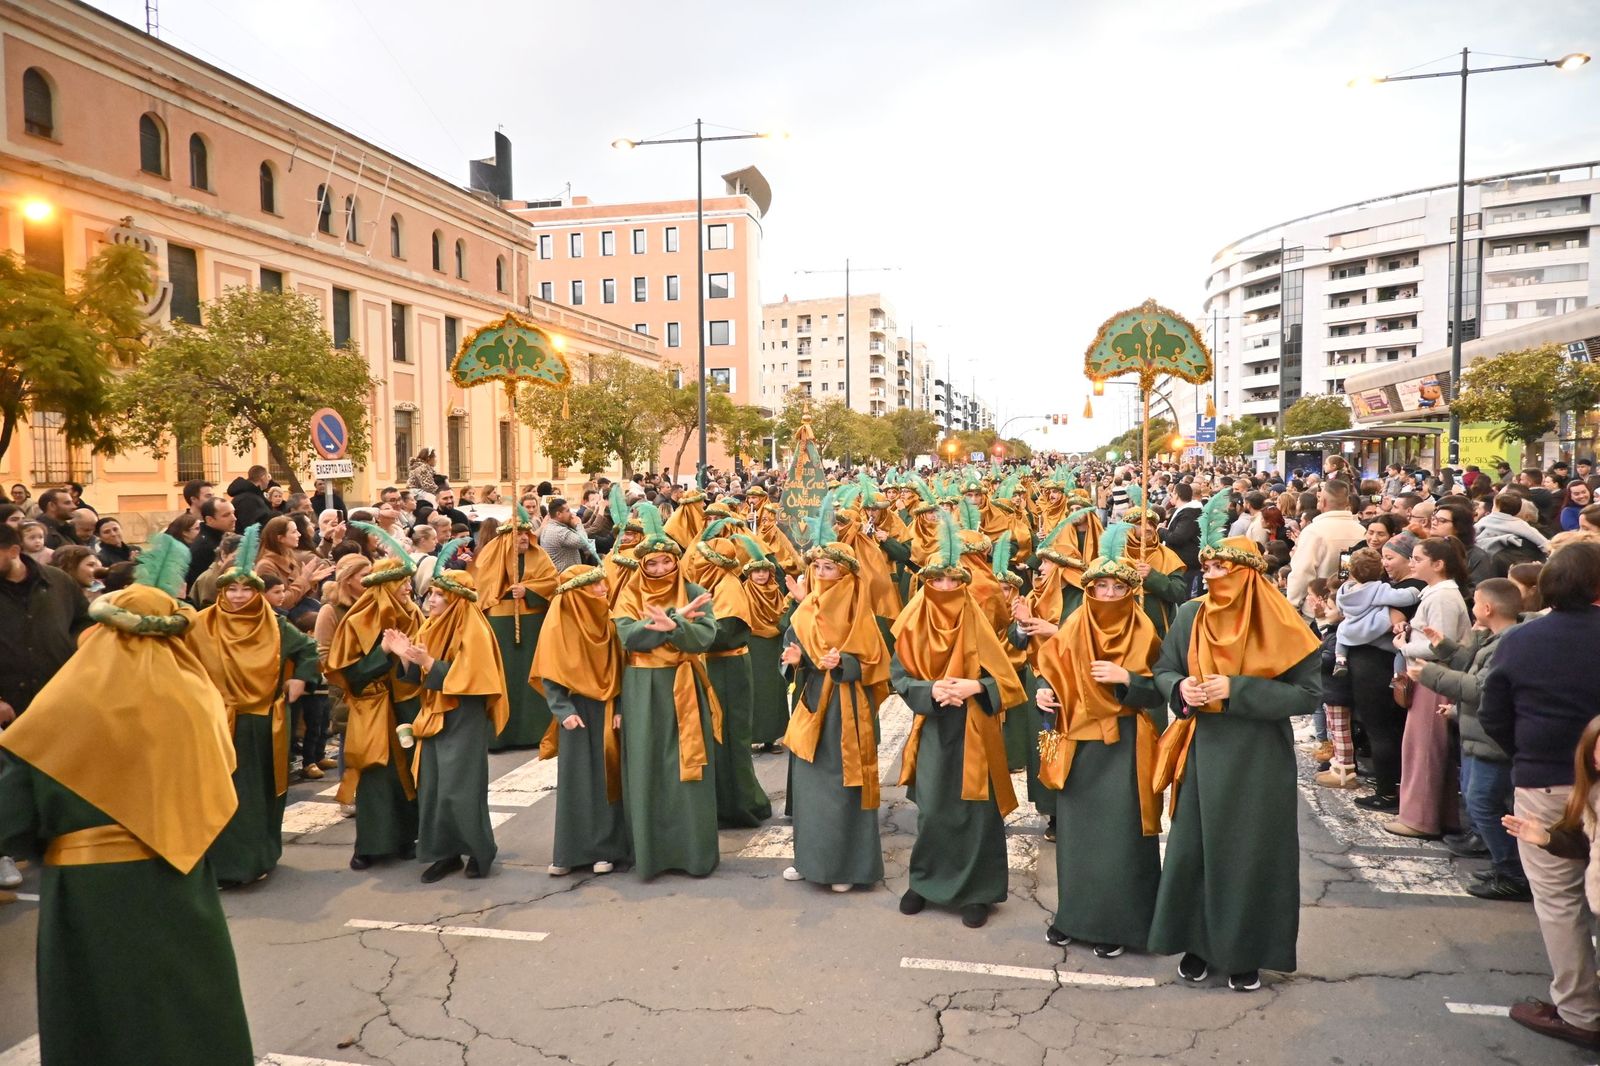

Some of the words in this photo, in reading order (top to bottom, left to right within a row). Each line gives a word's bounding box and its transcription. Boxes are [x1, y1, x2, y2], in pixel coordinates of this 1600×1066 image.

[1201, 415, 1211, 426] P
[316, 464, 338, 475] EXCEPTO
[338, 463, 352, 473] TAXIS
[806, 477, 825, 489] Cruz
